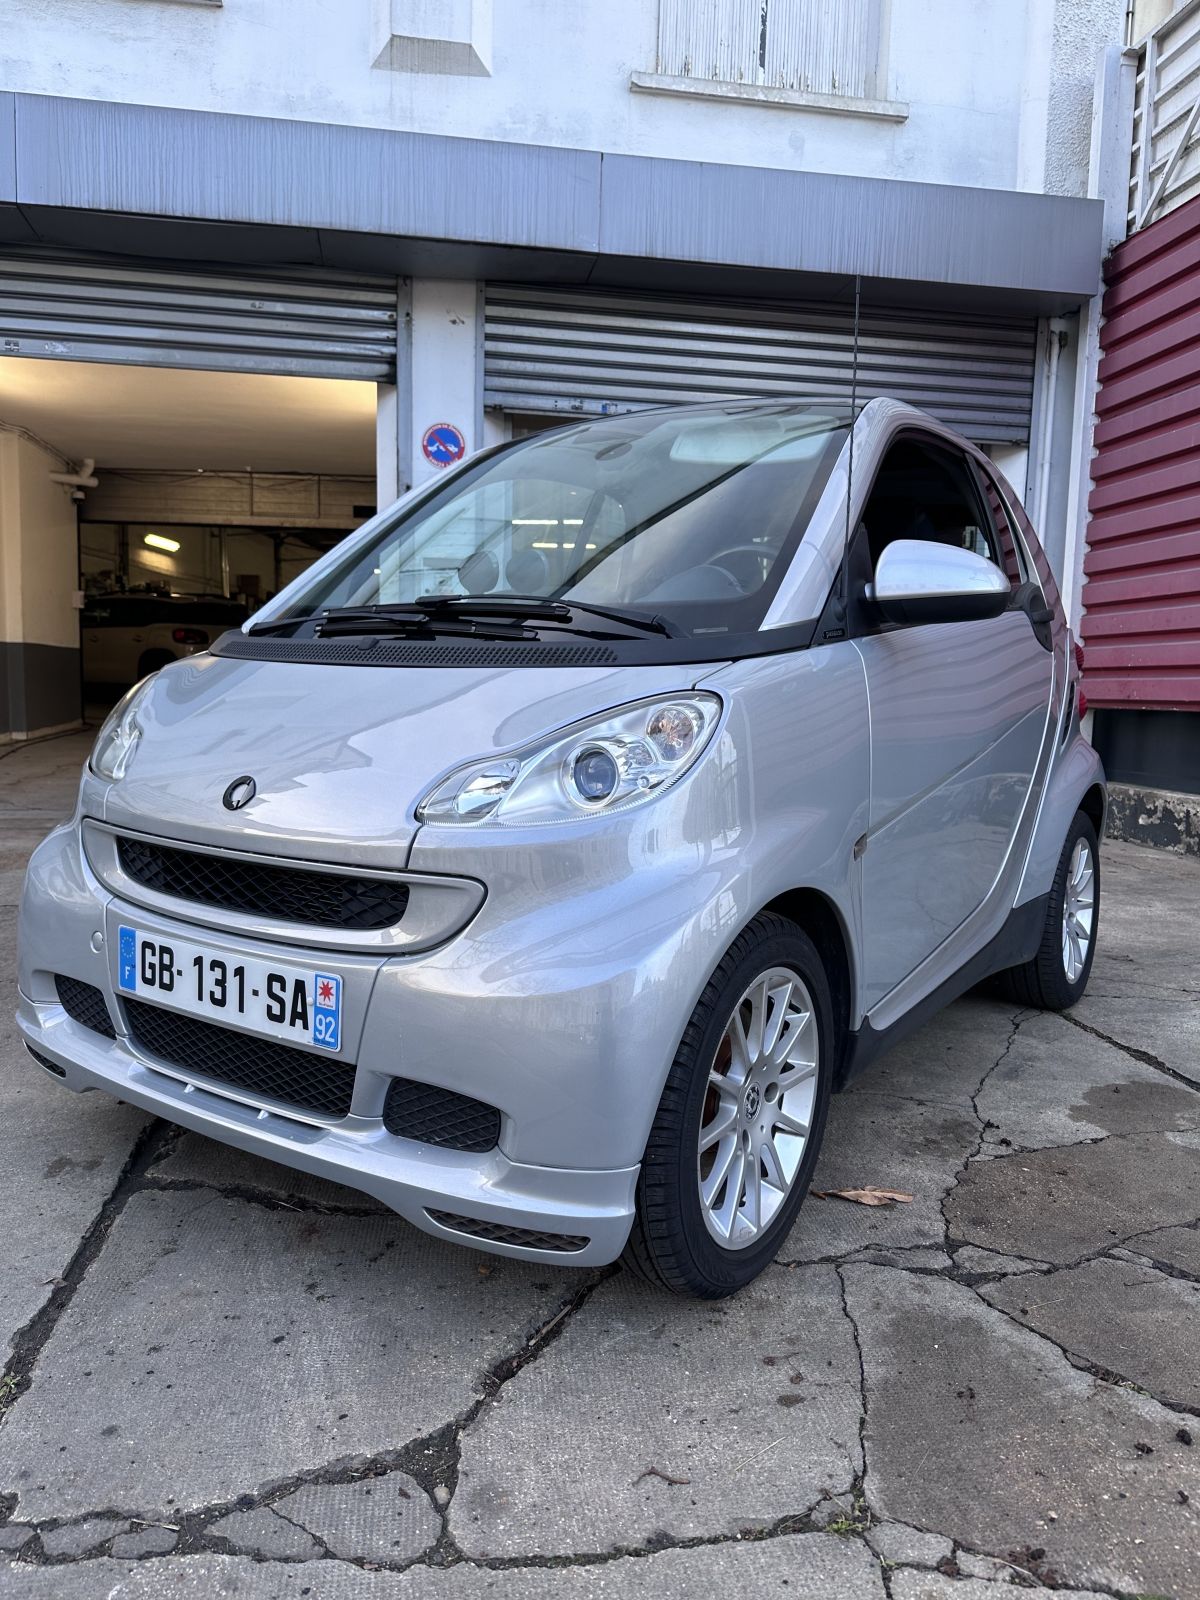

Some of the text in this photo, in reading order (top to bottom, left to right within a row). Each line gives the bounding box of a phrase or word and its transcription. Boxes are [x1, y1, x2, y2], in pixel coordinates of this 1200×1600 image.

[125, 966, 131, 980] F
[140, 940, 309, 1031] GB-131-SA
[315, 1014, 336, 1043] 92
